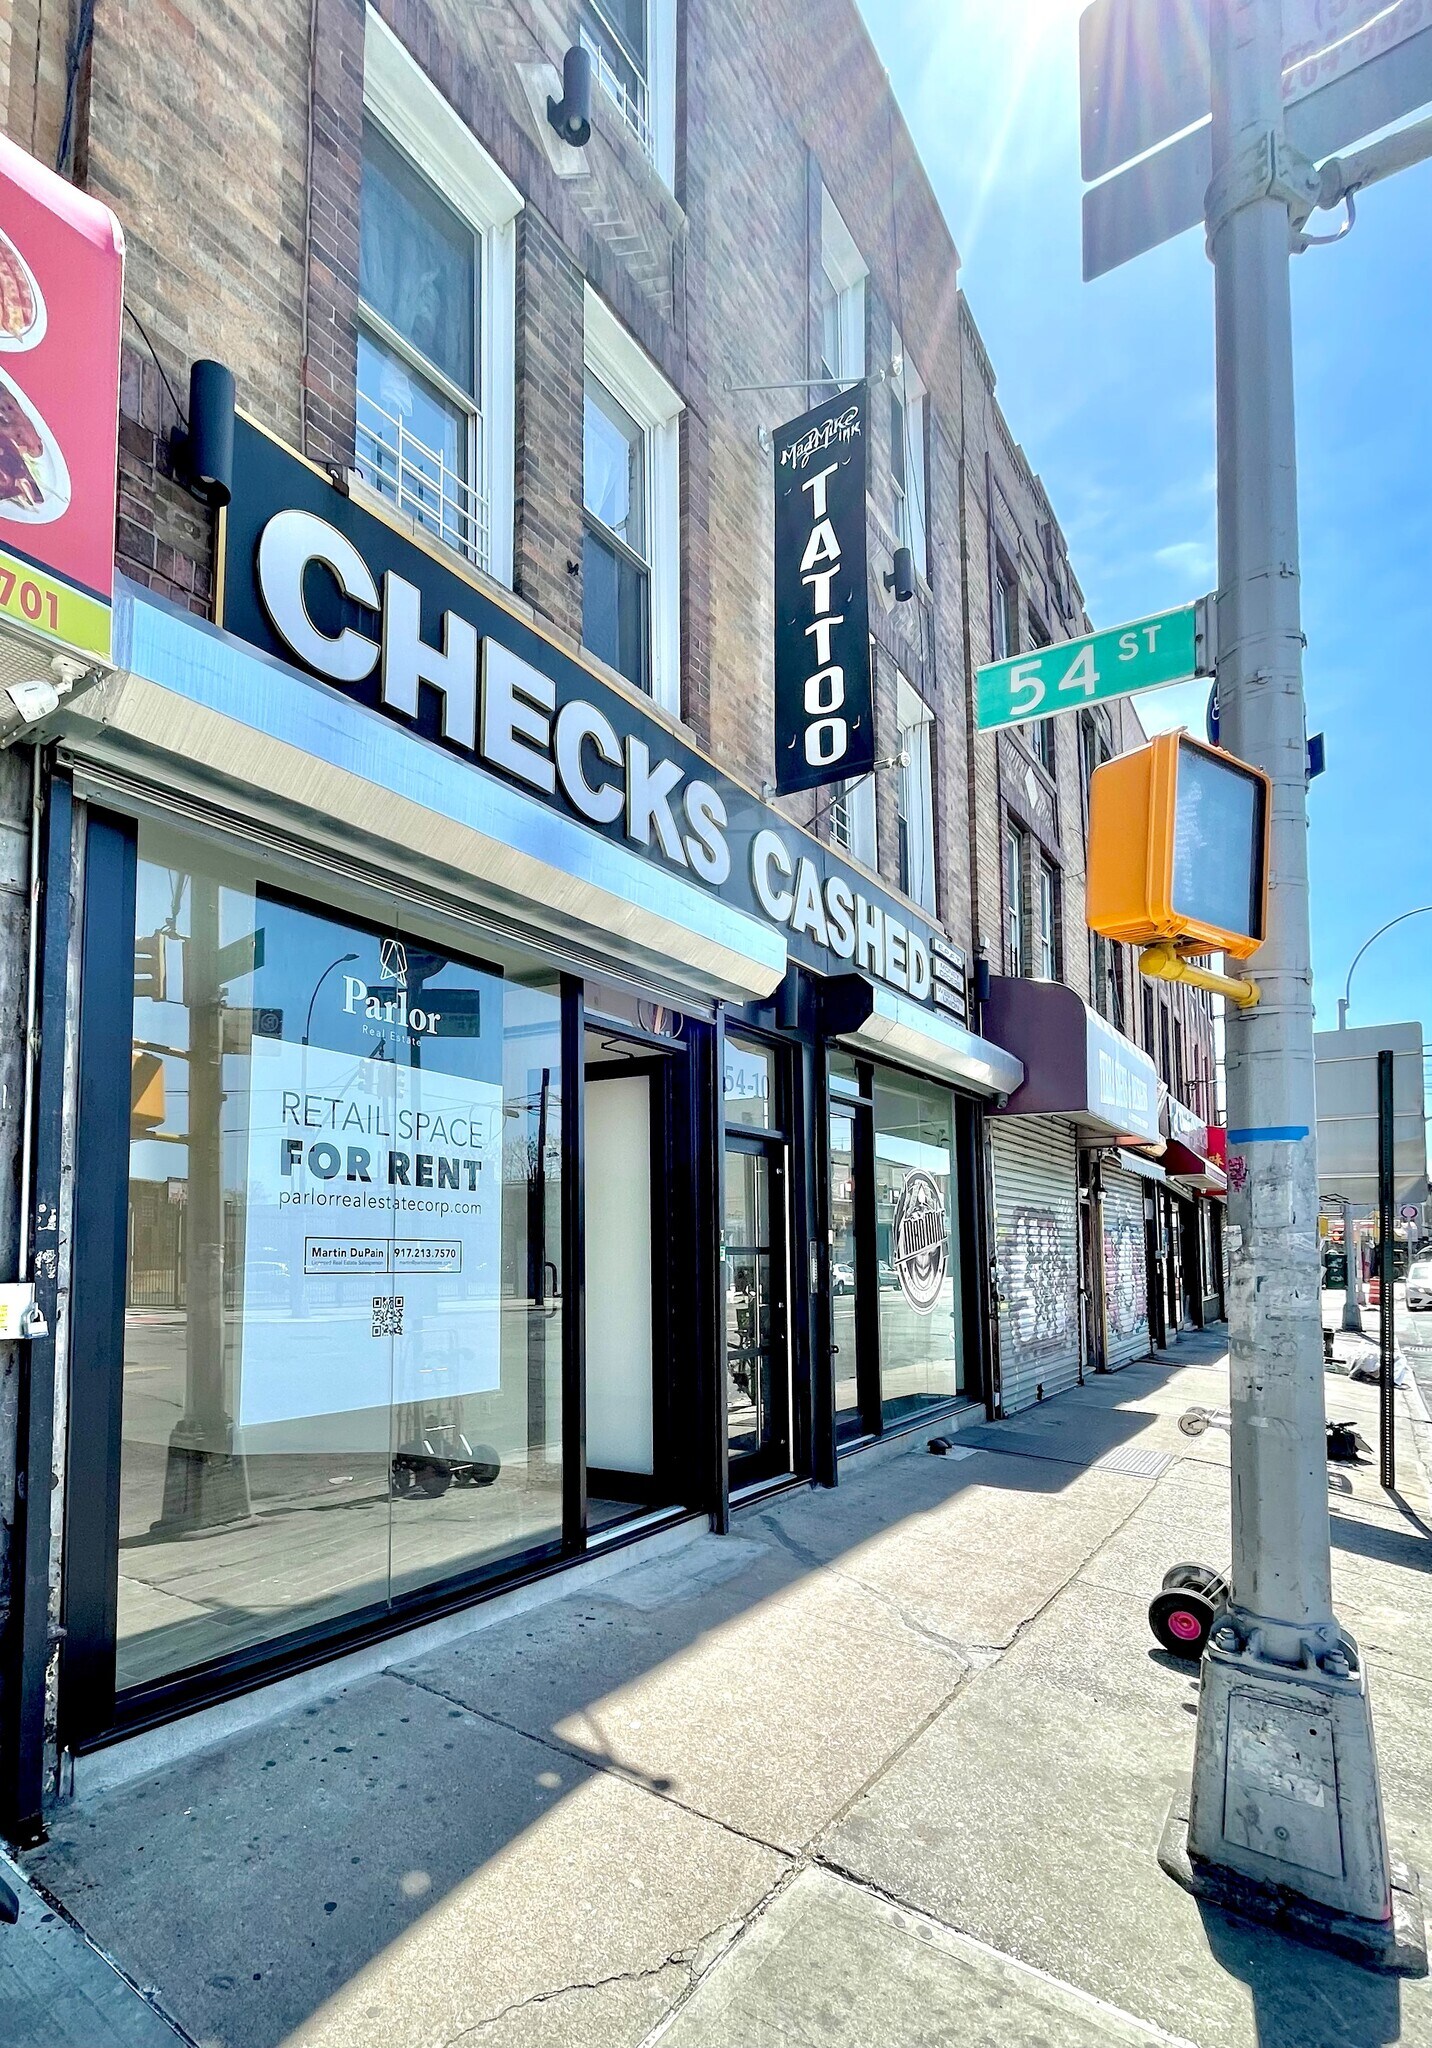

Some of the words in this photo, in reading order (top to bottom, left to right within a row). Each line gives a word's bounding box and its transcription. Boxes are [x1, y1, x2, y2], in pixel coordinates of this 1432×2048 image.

[799, 462, 848, 767] TATTOO
[1009, 643, 1100, 716] 54
[1117, 624, 1162, 662] ST
[259, 508, 731, 886] CHECKS
[752, 828, 931, 1001] CASHED
[342, 975, 441, 1035] Parlor
[362, 1024, 386, 1039] Real
[390, 1030, 422, 1047] Estate
[282, 1091, 390, 1137] RETAIL
[398, 1109, 483, 1149] SPACE
[280, 1138, 373, 1183] FOR
[388, 1150, 482, 1192] RENT
[279, 1187, 482, 1217] parlorrealestatecorp.com
[311, 1247, 347, 1258] Martin
[350, 1247, 384, 1258] DuPain
[394, 1248, 456, 1258] 917.213.7570
